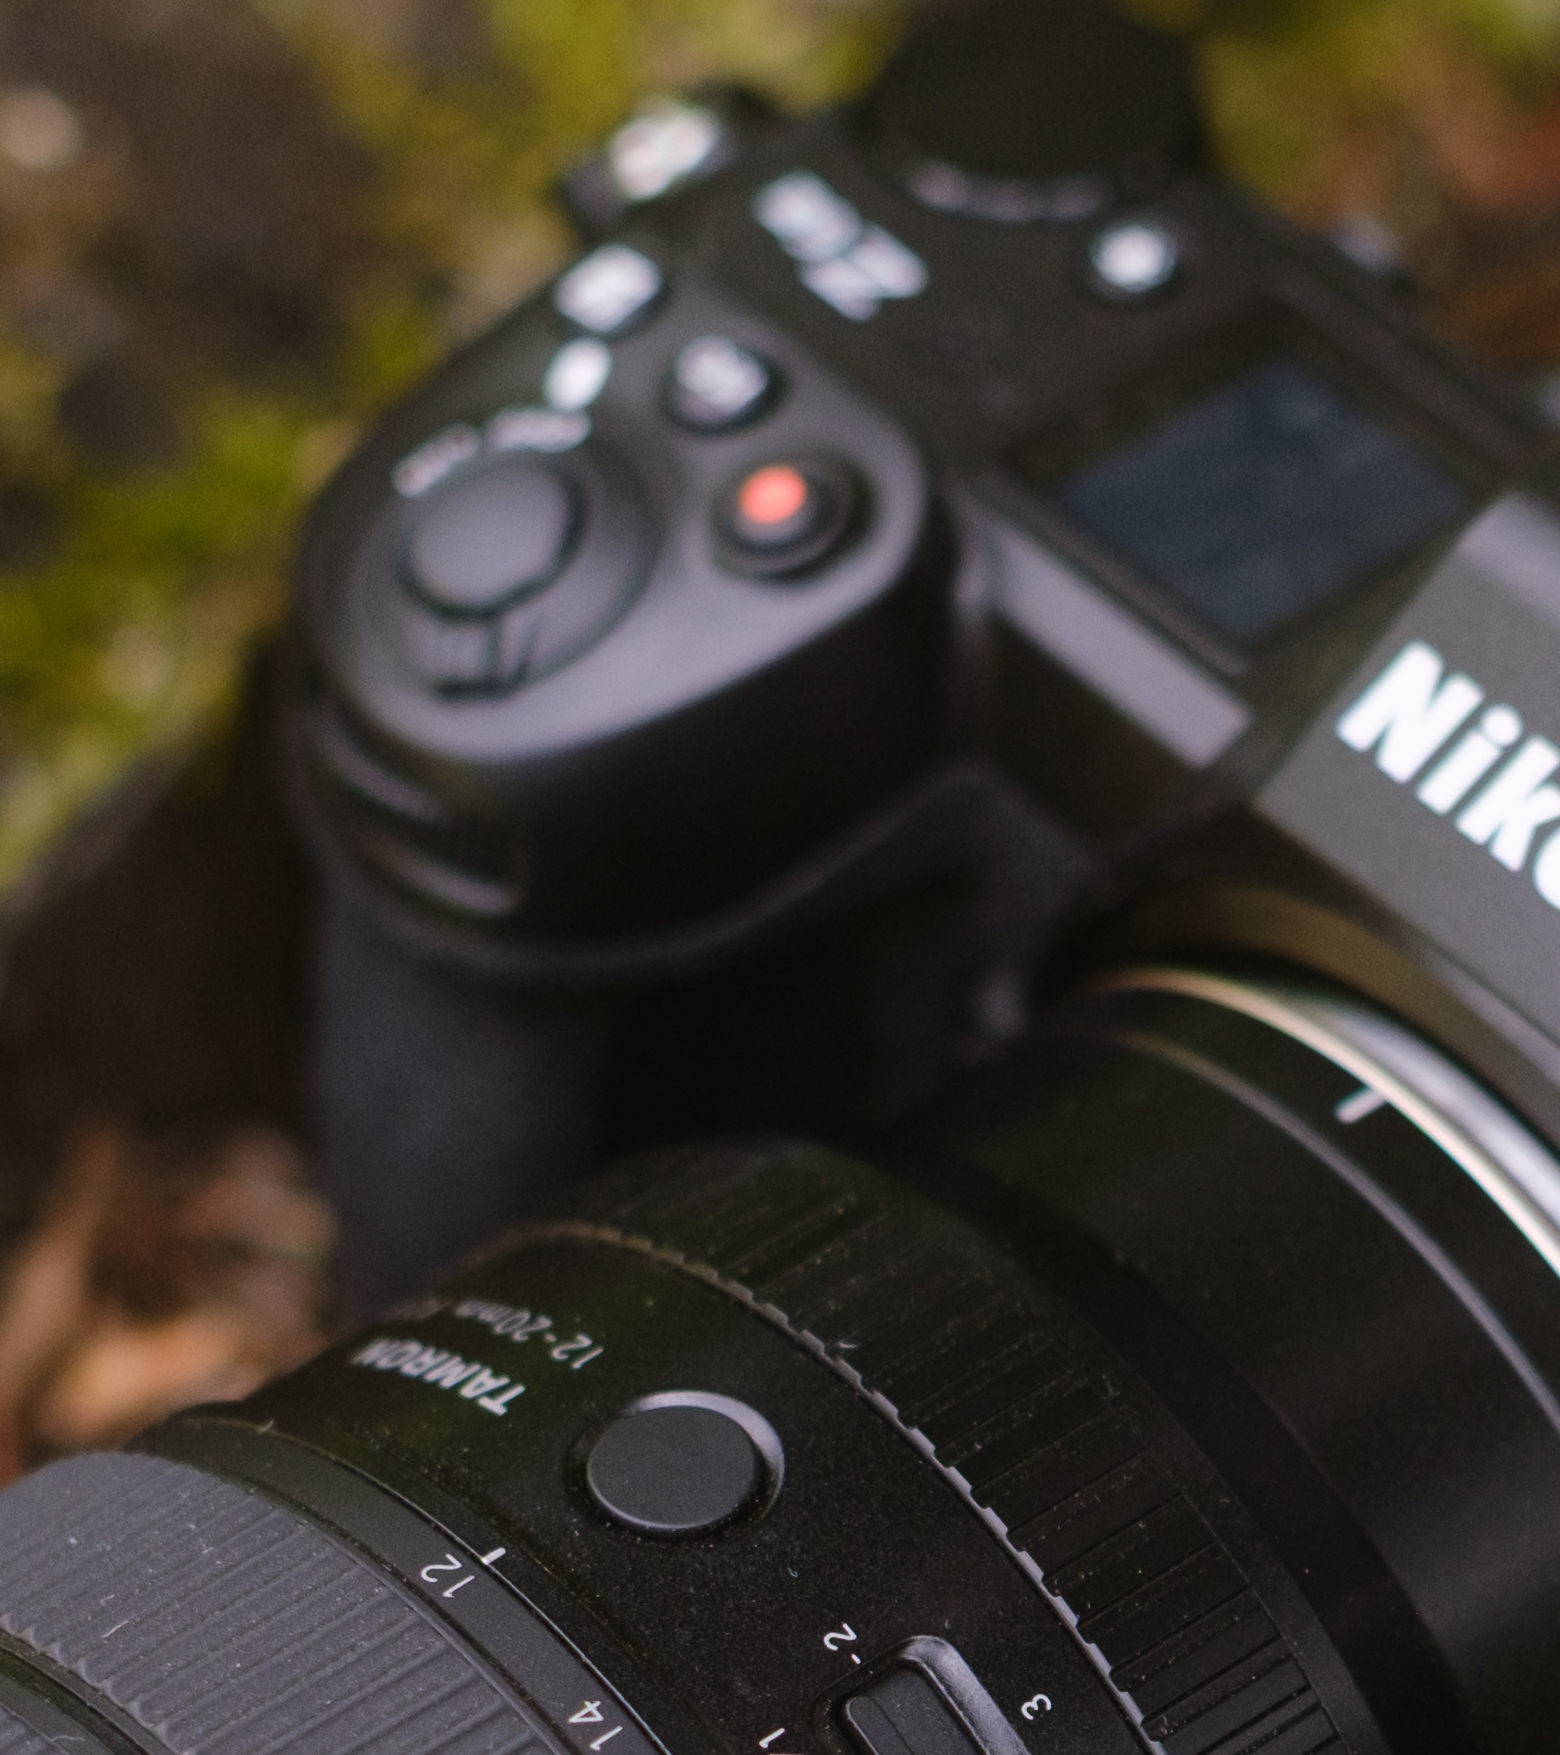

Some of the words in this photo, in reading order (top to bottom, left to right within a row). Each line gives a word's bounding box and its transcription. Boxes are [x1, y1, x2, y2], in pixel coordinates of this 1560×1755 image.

[351, 1335, 527, 1417] TAMRON
[419, 1552, 476, 1599] 12
[567, 1699, 623, 1753] 14
[1020, 1692, 1053, 1721] 3
